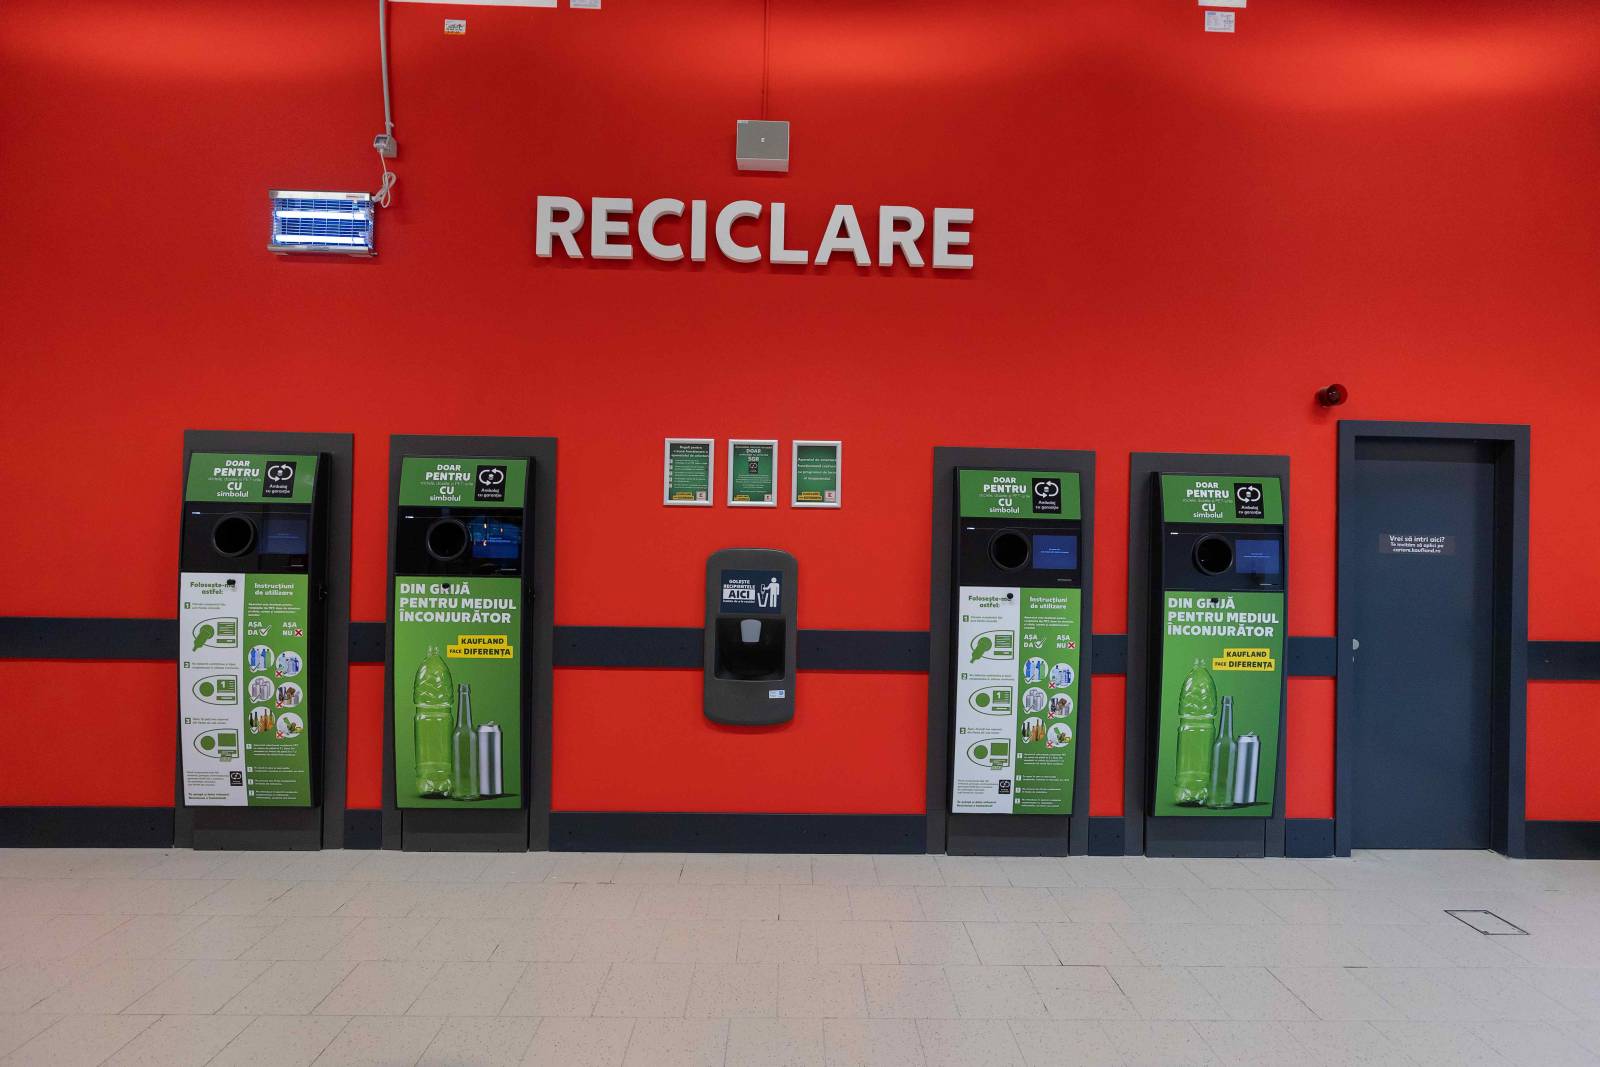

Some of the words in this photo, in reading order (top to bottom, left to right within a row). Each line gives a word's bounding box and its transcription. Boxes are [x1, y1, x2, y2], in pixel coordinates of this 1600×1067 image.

[535, 195, 975, 269] RECICLARE
[214, 468, 259, 477] PENTRU
[426, 472, 471, 481] PENTRU
[227, 482, 242, 491] CU
[440, 486, 455, 495] CU
[984, 484, 1027, 494] PENTRU
[217, 490, 249, 498] simbolul
[1186, 489, 1230, 499] PENTRU
[999, 498, 1012, 507] CU
[1202, 503, 1216, 512] CU
[400, 584, 426, 594] DIN
[728, 590, 750, 599] AICI
[400, 598, 458, 609] PENTRU
[461, 598, 517, 610] MEDIUL
[1030, 596, 1068, 604] Instrucțiuni
[1168, 598, 1193, 609] DIN
[400, 609, 511, 624] ÎNCONJURĂTOR
[1168, 611, 1224, 623] PENTRU
[1227, 612, 1279, 624] MEDIUL
[1168, 622, 1274, 637] ÎNCONJURĂTOR
[464, 649, 511, 657] DIFERENȚA
[1229, 661, 1273, 670] DIFERENȚA
